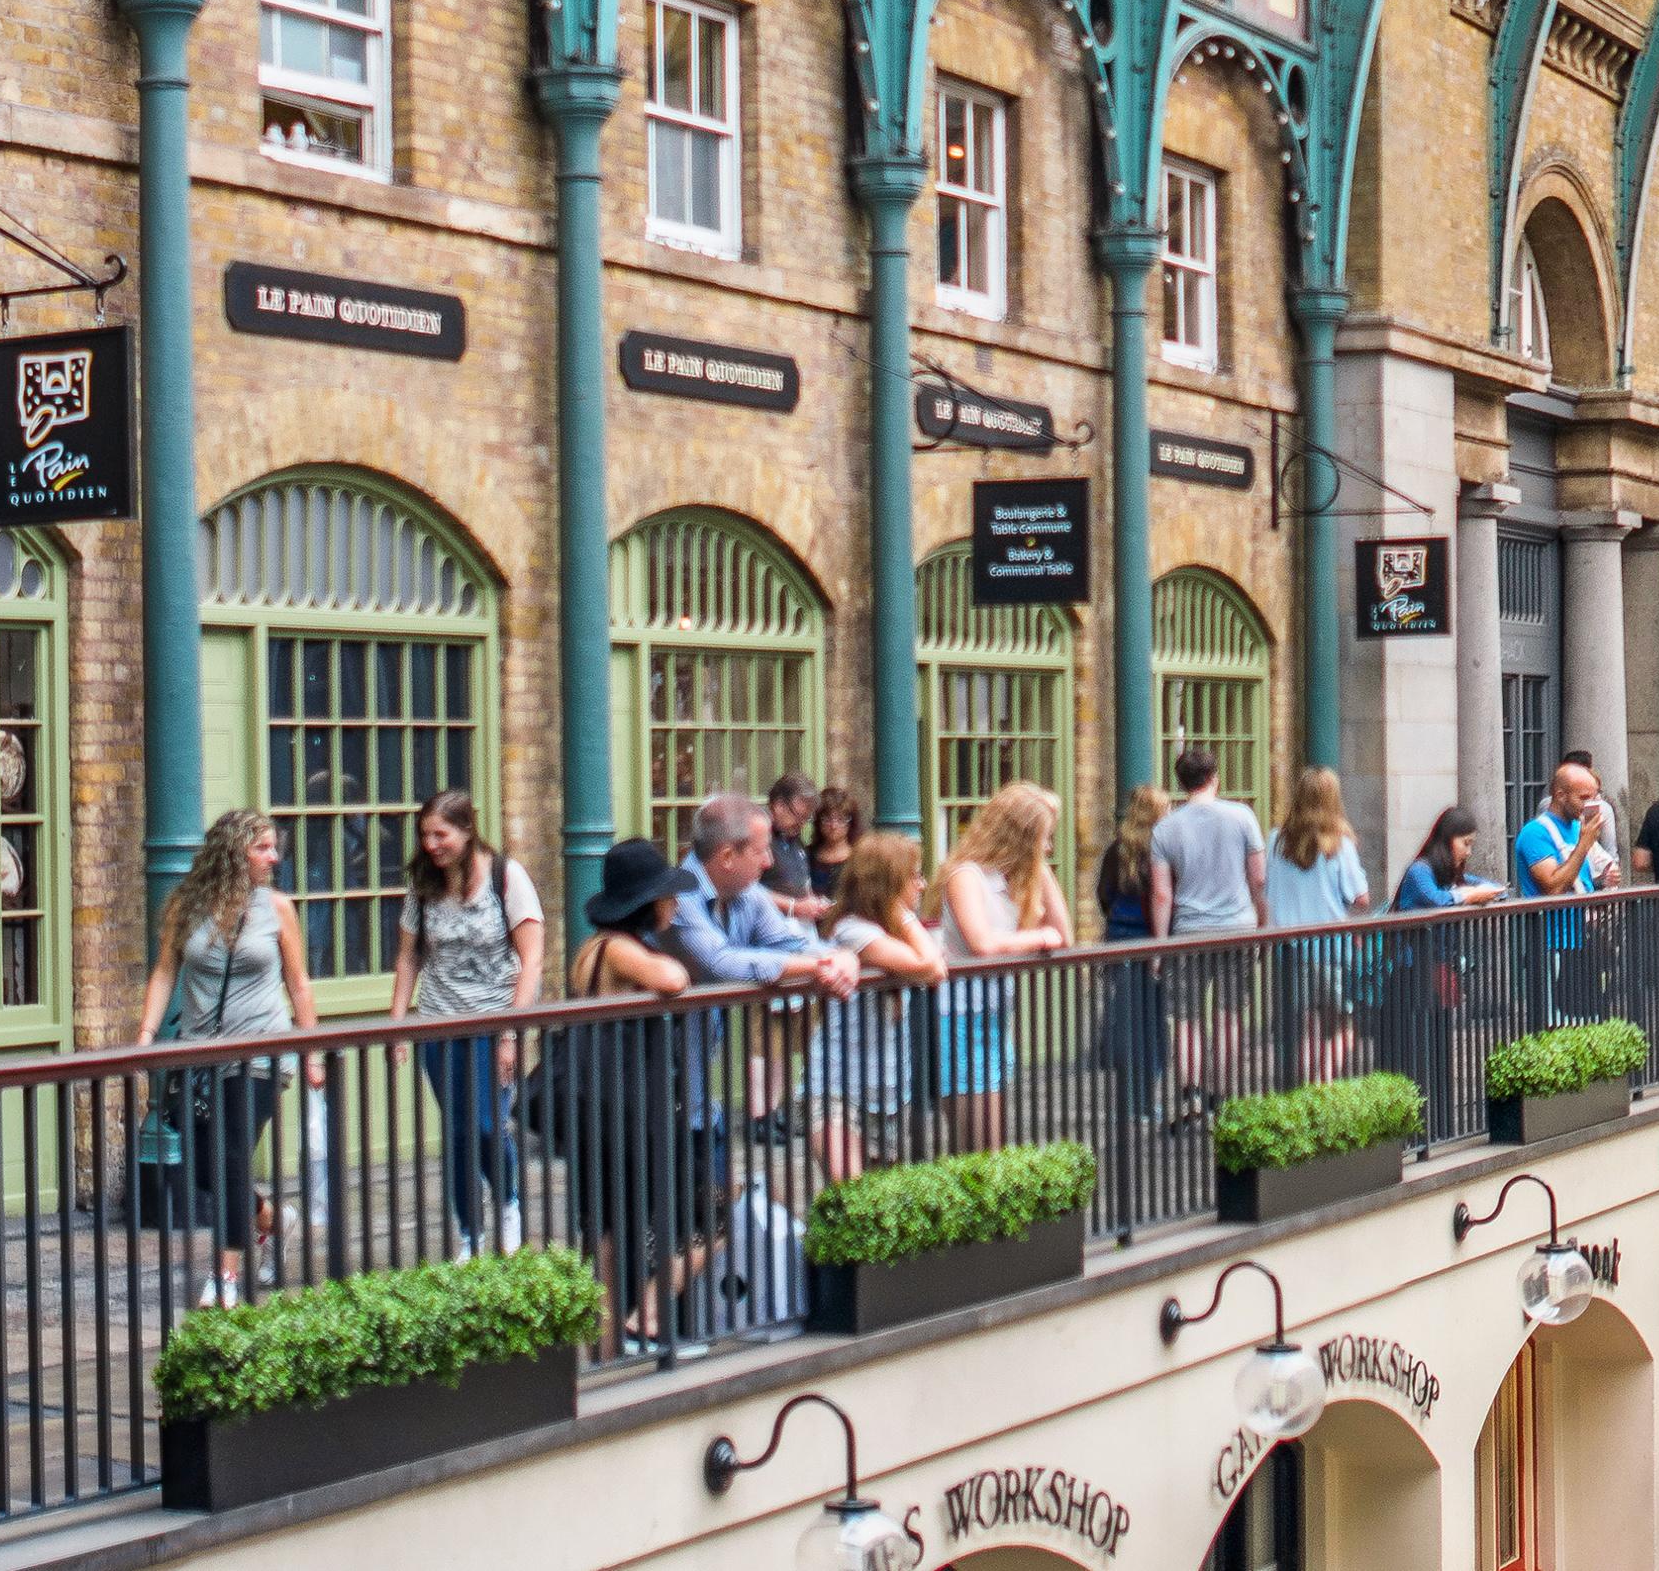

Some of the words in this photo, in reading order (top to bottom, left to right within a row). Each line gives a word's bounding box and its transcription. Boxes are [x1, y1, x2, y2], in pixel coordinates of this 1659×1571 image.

[257, 281, 286, 312] LE
[288, 286, 337, 320] PAIN
[339, 296, 442, 336] QUOTIDIEN
[643, 348, 666, 373] LE
[667, 352, 704, 379] PAIN
[705, 358, 784, 392] QUOTIDIEN
[934, 399, 954, 421] LE
[958, 404, 981, 426] AIN
[20, 440, 90, 489] Pain
[8, 485, 107, 508] QUOTIDIEN
[994, 505, 1055, 522] Boulangerie
[1056, 503, 1067, 518] &
[990, 521, 1018, 536] Table
[1019, 520, 1072, 535] Commune
[1007, 548, 1044, 564] Bakery
[1043, 546, 1055, 561] &
[989, 563, 1044, 578] Communal
[1044, 561, 1074, 576] Table
[1317, 1333, 1441, 1419] WORKSHOP
[944, 1466, 1131, 1558] WORKSHOP
